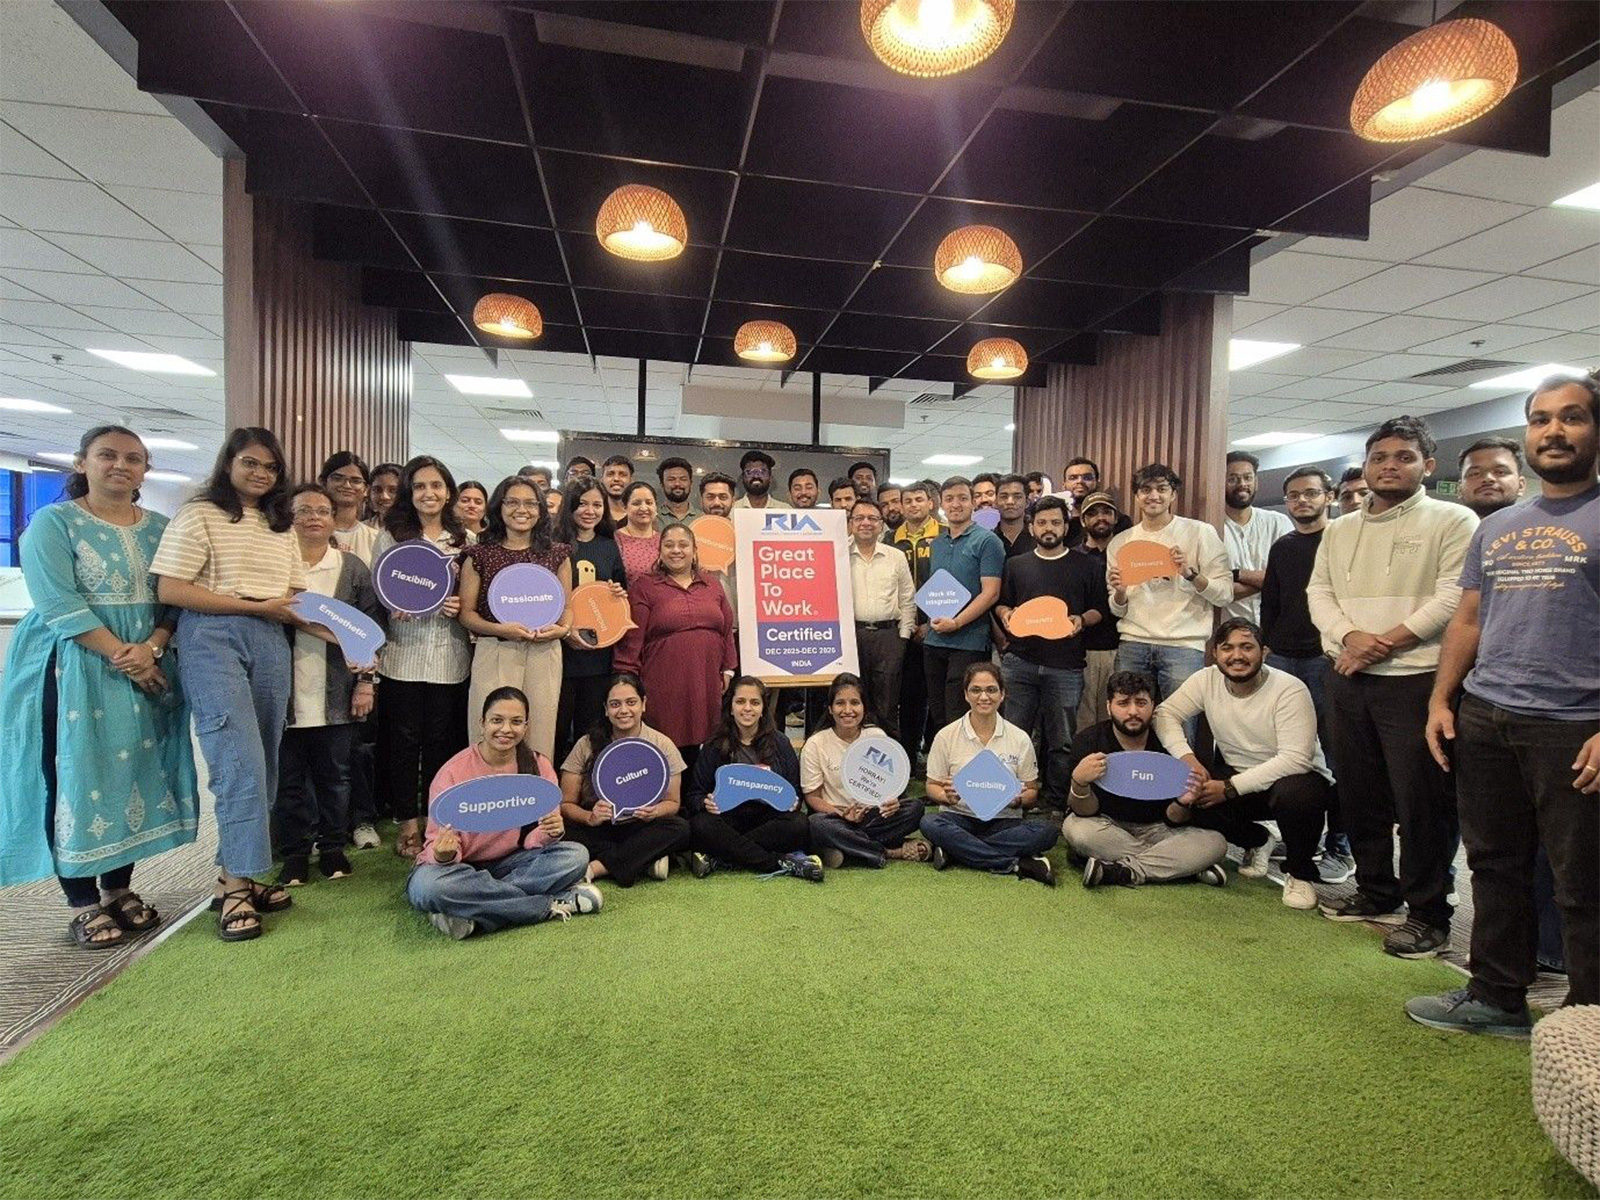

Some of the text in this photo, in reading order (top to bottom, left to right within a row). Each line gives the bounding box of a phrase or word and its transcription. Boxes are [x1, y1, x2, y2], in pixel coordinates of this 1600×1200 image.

[761, 513, 822, 531] RIA
[1485, 526, 1587, 556] LEVI STRAUSS
[1515, 538, 1555, 551] & CO.
[758, 546, 815, 562] Great
[1564, 555, 1588, 564] MRK
[391, 569, 437, 590] Flexibility
[760, 564, 816, 579] Place
[760, 582, 782, 597] To
[500, 593, 554, 604] Passionate
[318, 603, 368, 640] Empathetic
[766, 627, 833, 642] Certified
[863, 746, 895, 774] RIA
[615, 766, 649, 786] Culture
[1131, 769, 1154, 781] Fun
[727, 776, 784, 794] Transparency
[965, 779, 1007, 792] Credibility
[458, 794, 537, 814] Supportive
